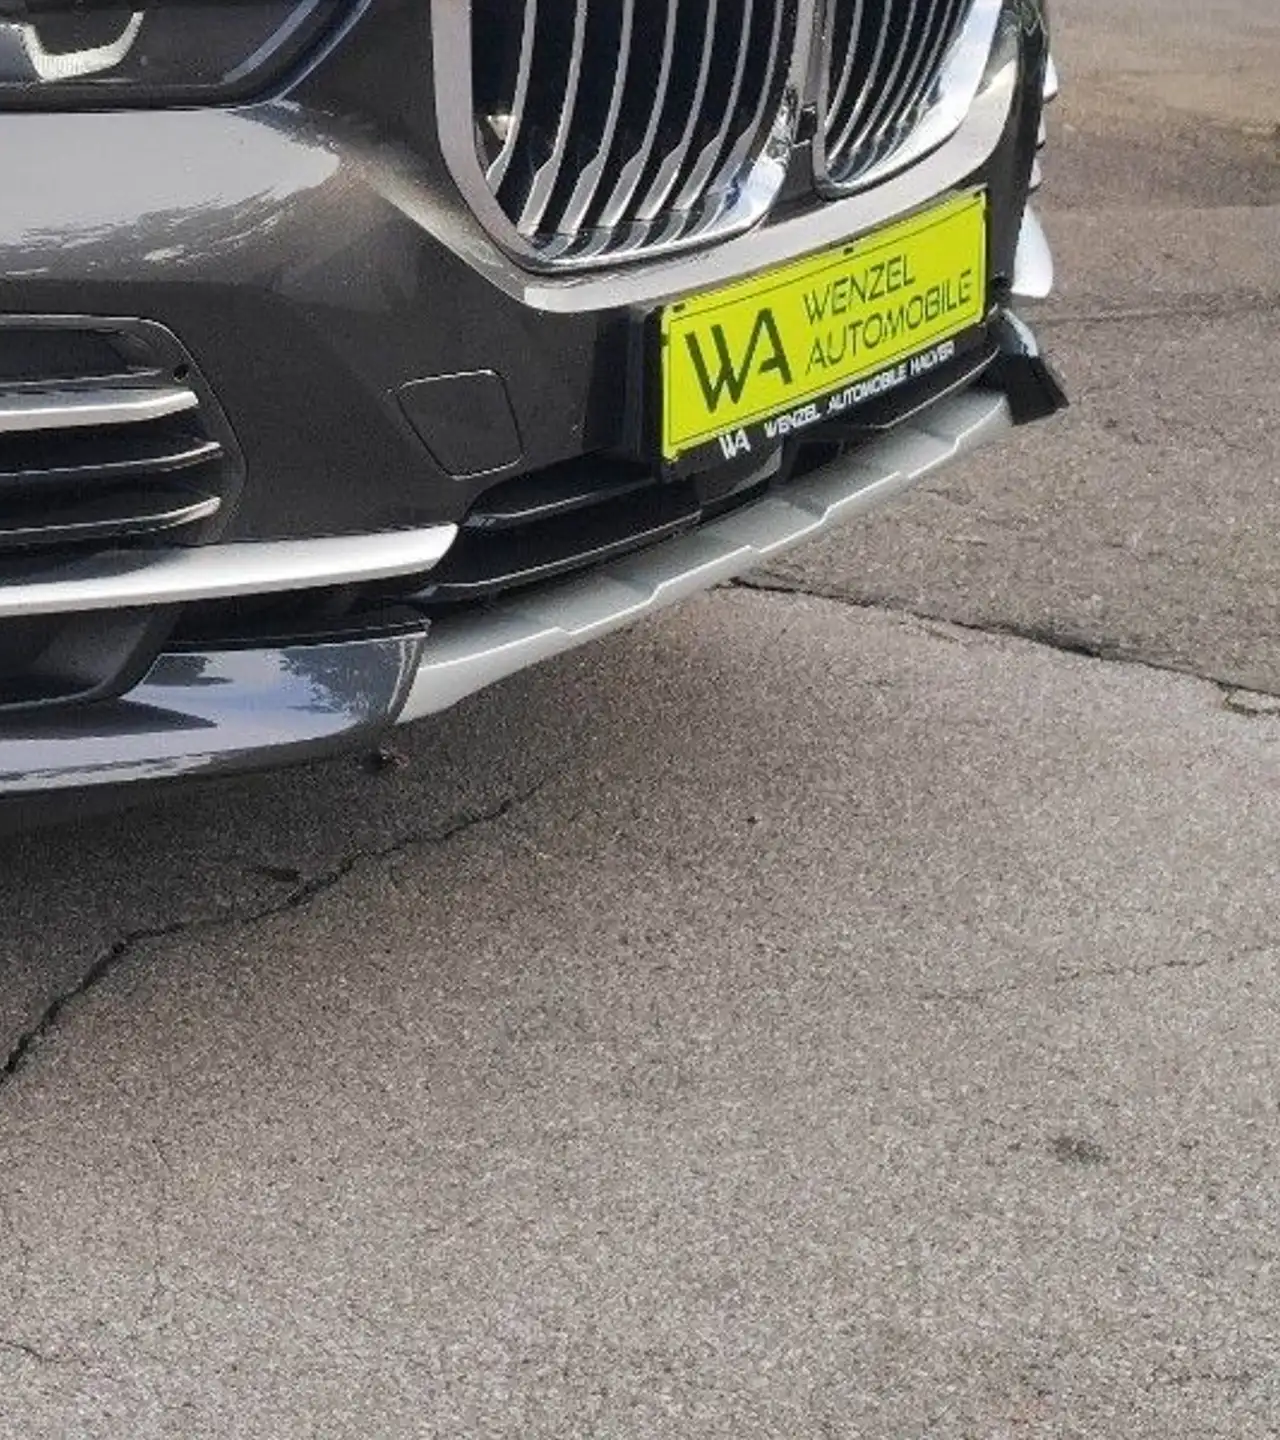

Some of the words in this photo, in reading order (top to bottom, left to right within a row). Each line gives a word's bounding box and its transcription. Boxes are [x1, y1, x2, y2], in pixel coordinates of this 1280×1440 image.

[803, 254, 915, 325] WENZEL
[806, 269, 972, 375] AUTOMOBILE
[685, 307, 792, 414] WA
[718, 428, 751, 460] WA
[764, 403, 821, 438] WENZEL
[827, 364, 907, 414] AUTOMOBILE
